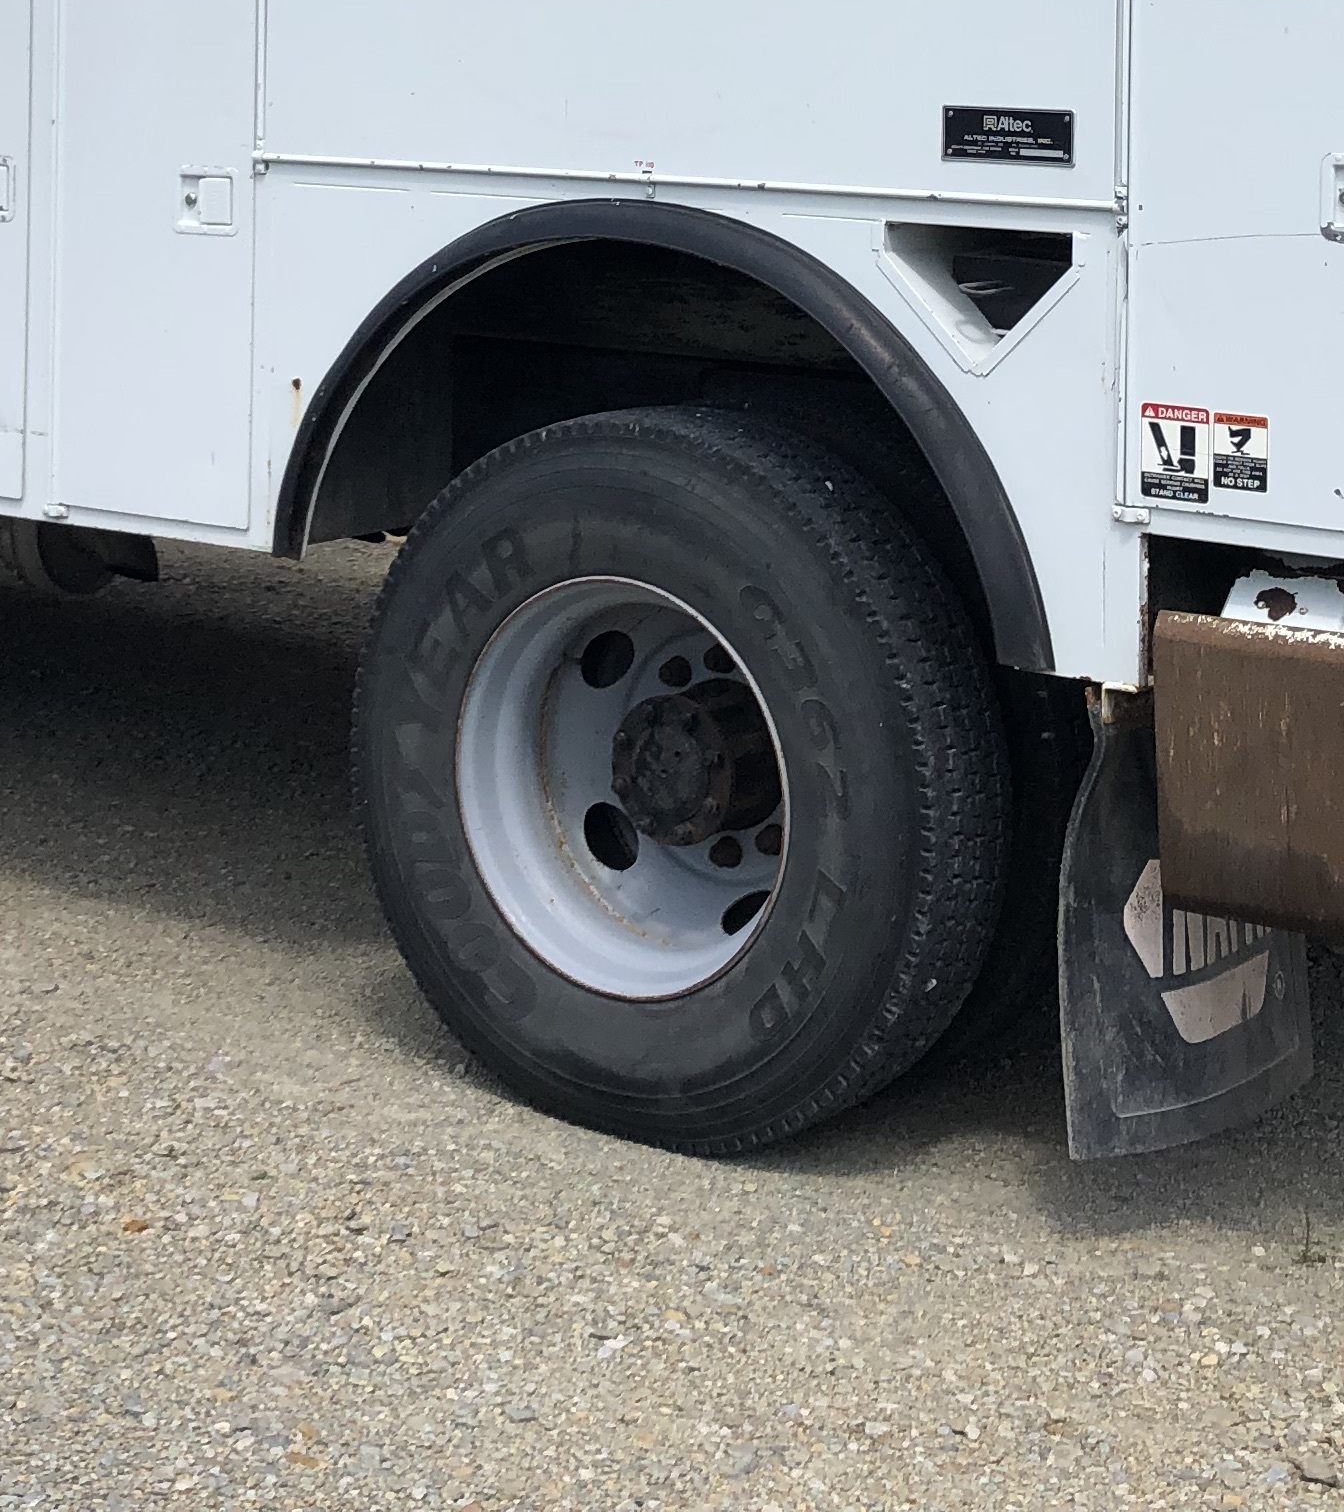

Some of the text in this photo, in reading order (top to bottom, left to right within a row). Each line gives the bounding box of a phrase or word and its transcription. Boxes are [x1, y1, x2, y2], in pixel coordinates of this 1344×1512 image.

[997, 116, 1032, 132] Altec
[1158, 407, 1207, 422] DANGER
[1226, 416, 1266, 426] WARNING
[1221, 476, 1260, 488] NO STEP
[1151, 488, 1199, 499] STAND CLEAR
[394, 524, 538, 1021] GOODYEAR
